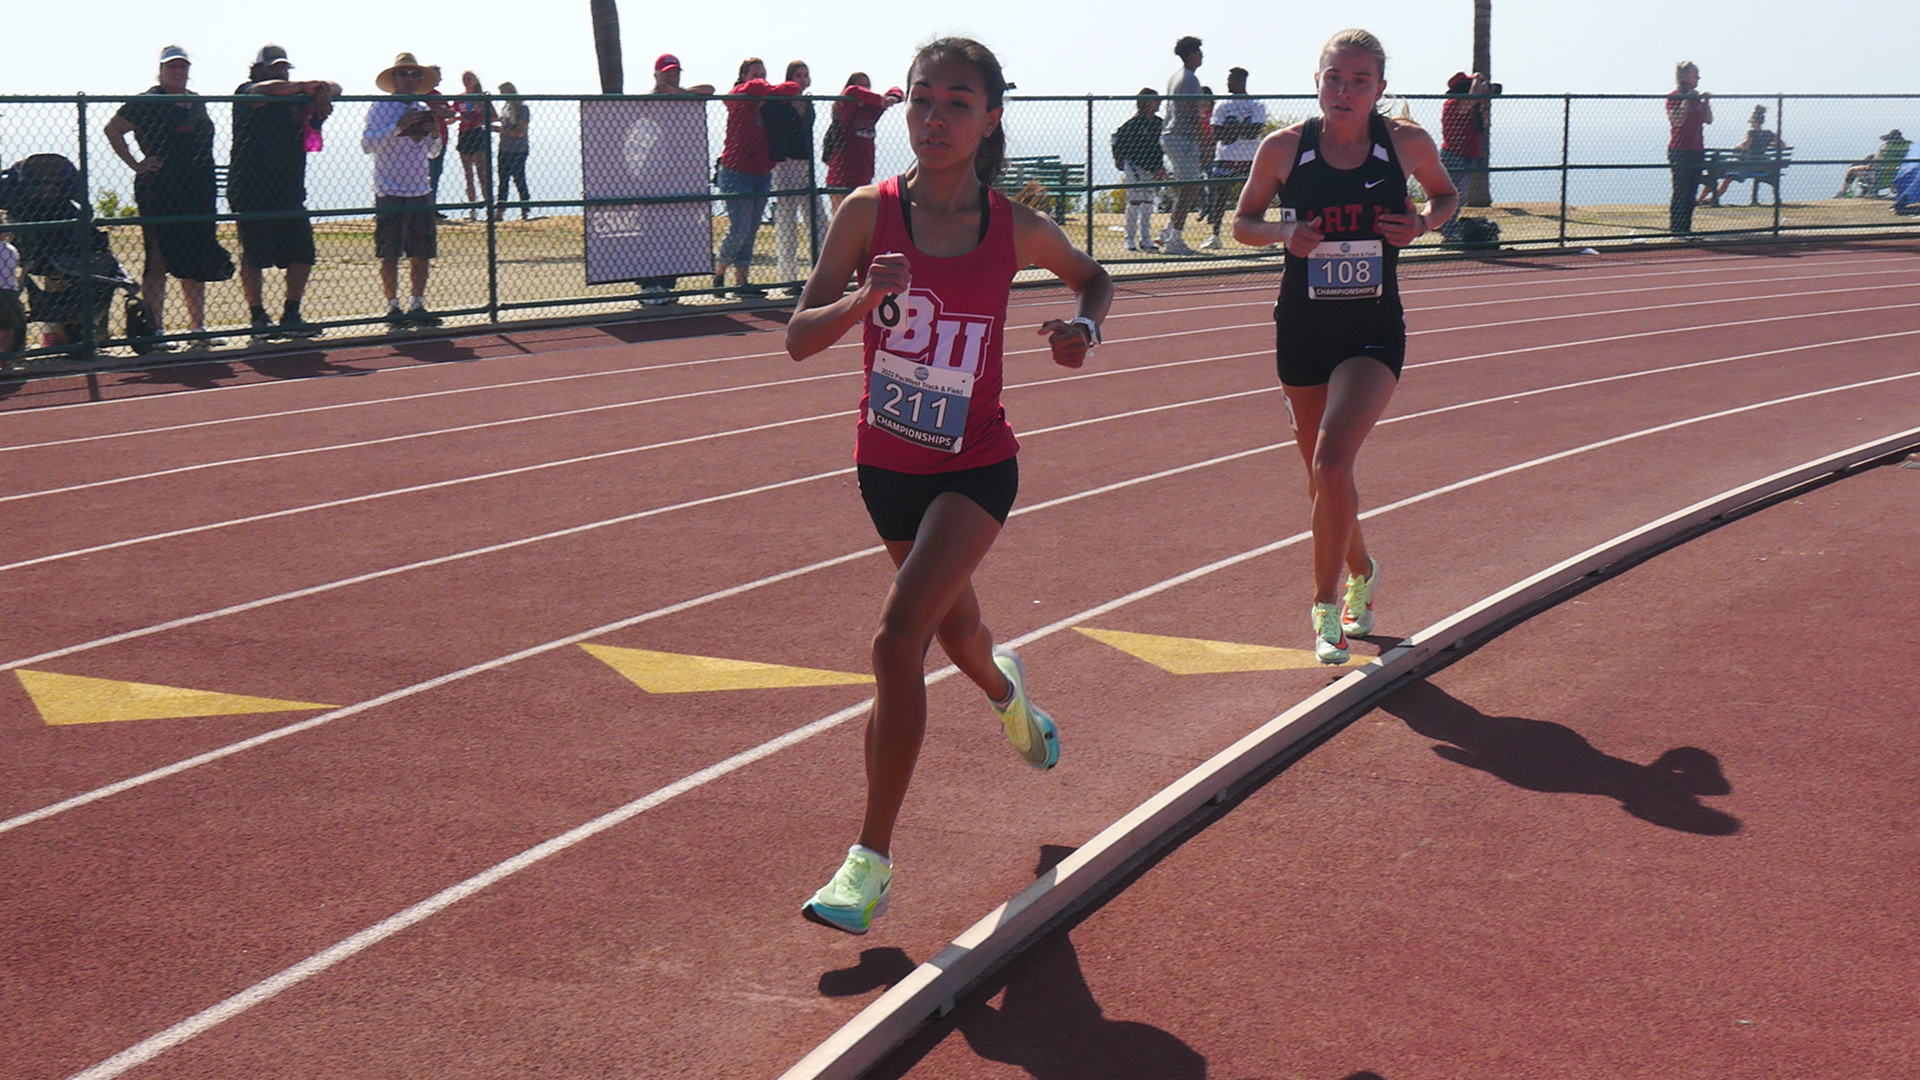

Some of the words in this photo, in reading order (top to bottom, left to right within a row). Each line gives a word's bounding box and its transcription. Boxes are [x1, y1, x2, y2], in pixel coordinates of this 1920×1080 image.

[1321, 260, 1371, 284] 108
[1316, 286, 1376, 296] CHAMPIONSHIPS
[882, 291, 991, 375] BU
[881, 367, 895, 378] 2022
[895, 373, 921, 387] PacWest
[922, 381, 939, 392] Track
[947, 386, 964, 396] Field
[882, 382, 949, 430] 211
[876, 414, 953, 447] CHAMPIONSHIPS
